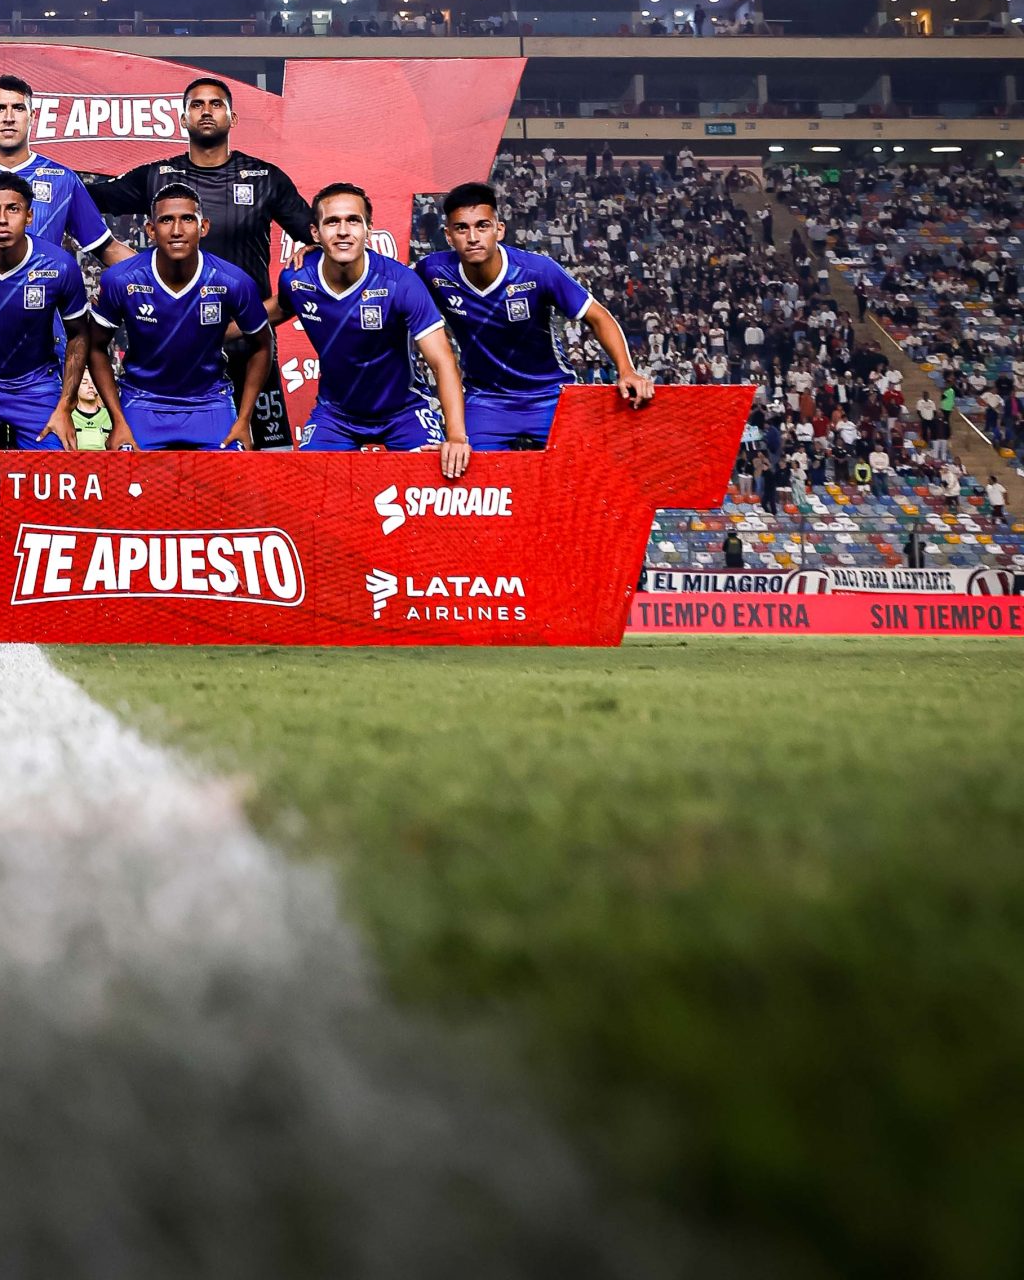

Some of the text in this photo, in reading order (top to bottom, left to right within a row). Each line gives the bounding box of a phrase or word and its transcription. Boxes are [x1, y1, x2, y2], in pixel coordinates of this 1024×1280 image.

[63, 98, 190, 139] APUEST
[255, 390, 283, 421] 95
[414, 408, 440, 430] 16
[405, 487, 513, 517] SPORADE
[20, 532, 77, 596] TE
[82, 534, 297, 599] APUESTO
[406, 576, 525, 597] LATAM
[655, 573, 783, 593] EL MILAGRO
[406, 606, 526, 621] AIRLINES
[638, 602, 727, 628] TIEMPO
[733, 603, 810, 628] EXTRA
[870, 604, 909, 629] SIN
[914, 605, 1003, 630] TIEMPO
